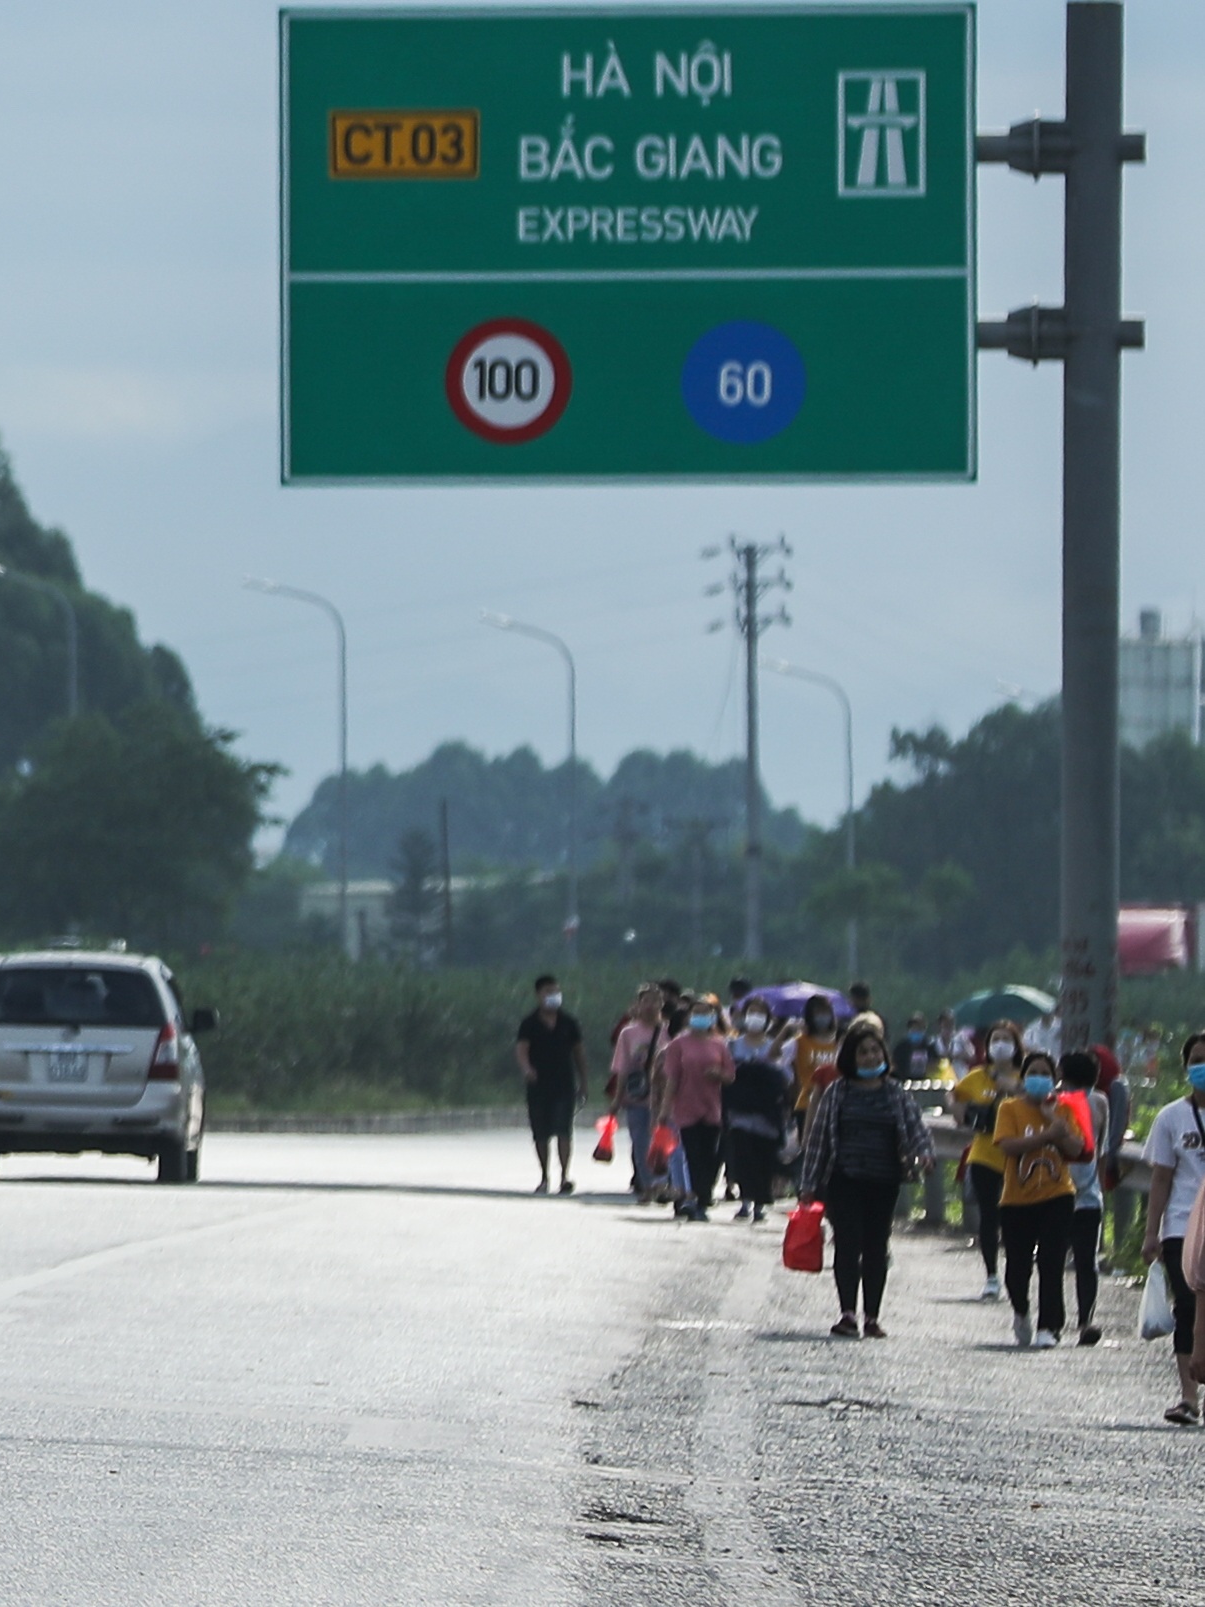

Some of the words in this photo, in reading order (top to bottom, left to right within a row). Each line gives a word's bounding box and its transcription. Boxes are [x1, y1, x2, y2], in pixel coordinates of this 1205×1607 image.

[561, 39, 630, 98] HÀ
[655, 39, 732, 106] NỘI
[342, 122, 466, 167] CT.03
[519, 114, 613, 180] BẮC
[635, 134, 783, 179] GIANG
[517, 207, 758, 243] EXPRESSWAY
[473, 358, 540, 402] 100
[718, 362, 771, 406] 60
